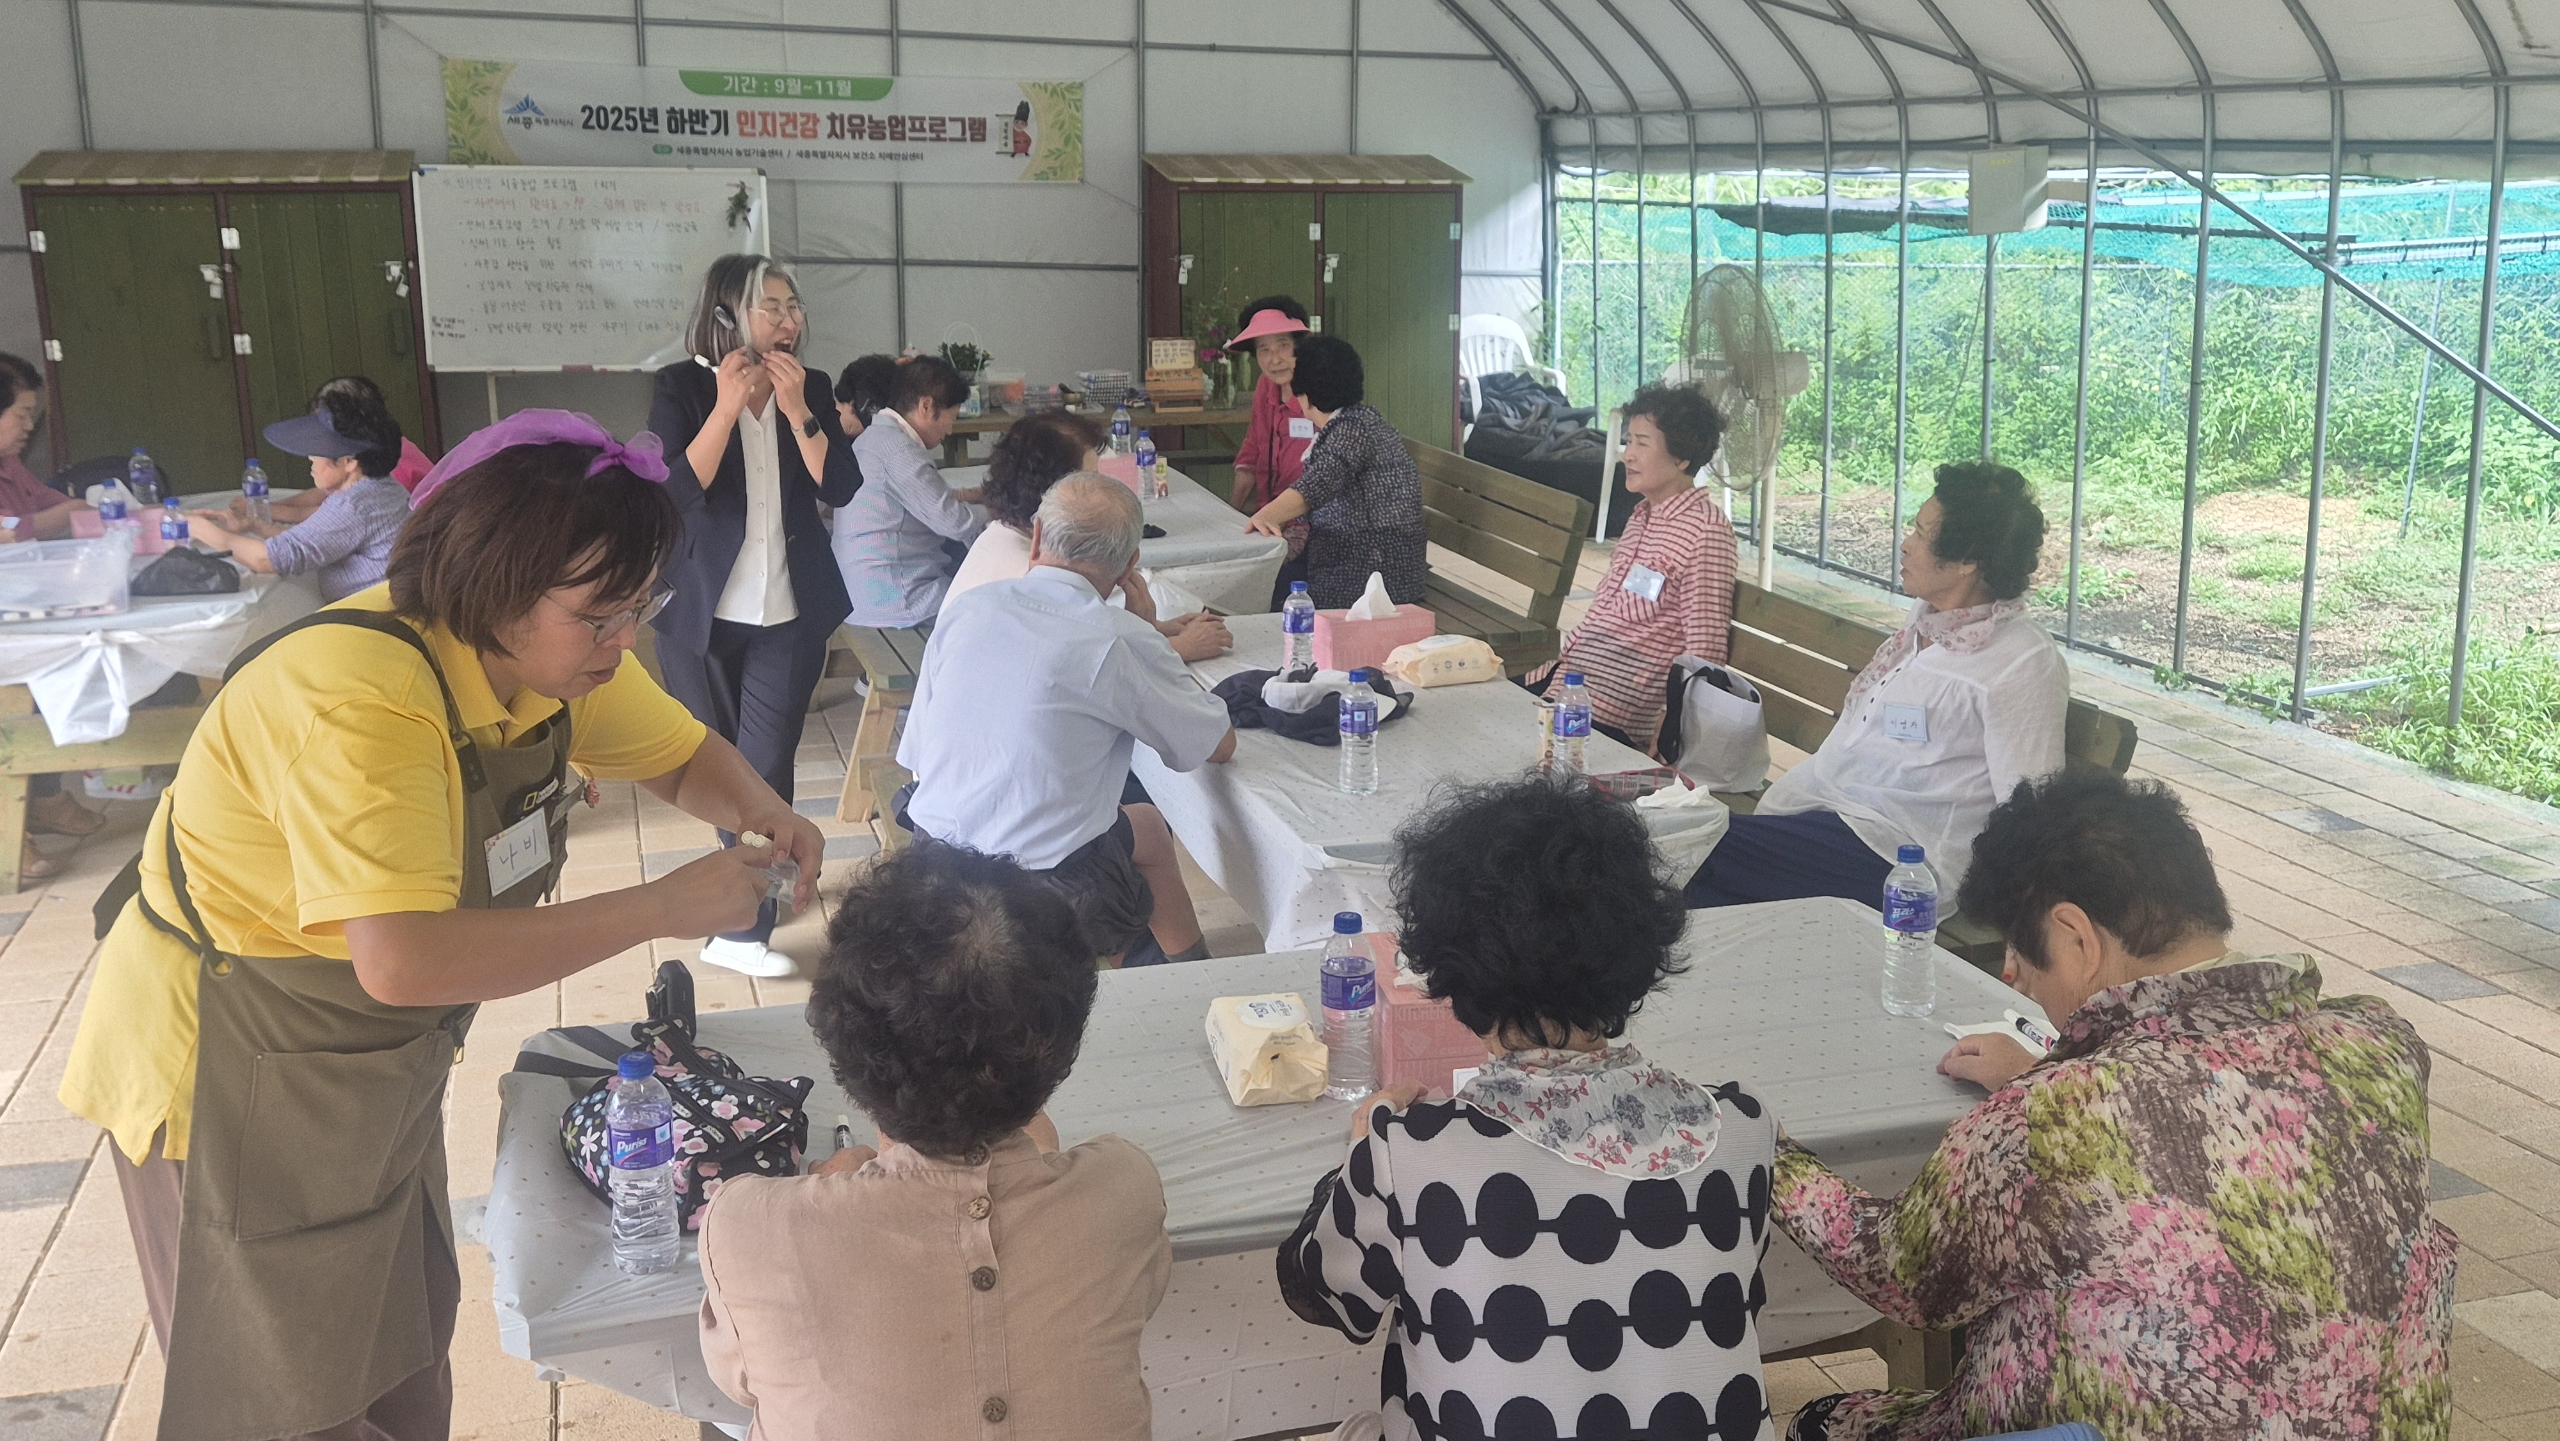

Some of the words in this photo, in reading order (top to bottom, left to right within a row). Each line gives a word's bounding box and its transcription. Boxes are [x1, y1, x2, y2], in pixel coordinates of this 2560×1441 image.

[723, 75, 757, 94] 기간
[580, 104, 659, 134] 2025년
[666, 106, 730, 136] 하반기
[736, 110, 820, 140] 인지건강
[826, 111, 987, 142] 치유농업프로그램
[735, 147, 783, 158] 농업기술센터
[852, 151, 876, 160] 보건소
[878, 151, 924, 161] 치매안심센터
[499, 828, 537, 871] 나비
